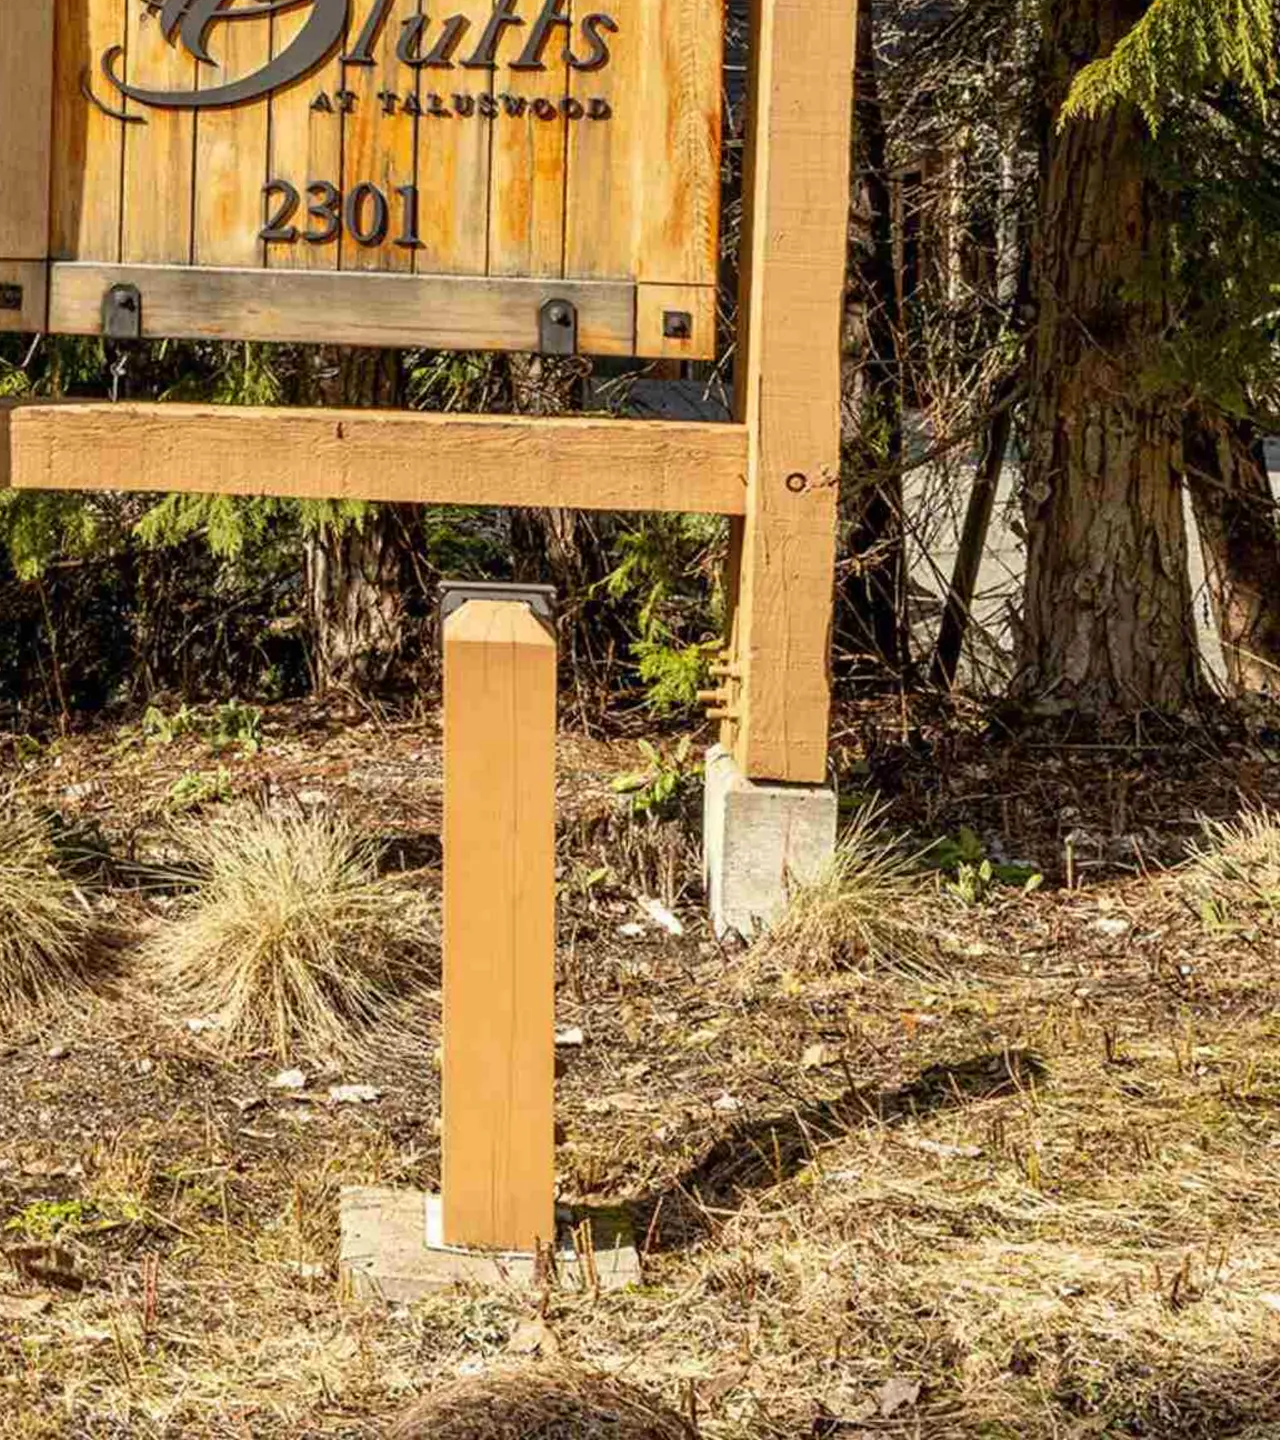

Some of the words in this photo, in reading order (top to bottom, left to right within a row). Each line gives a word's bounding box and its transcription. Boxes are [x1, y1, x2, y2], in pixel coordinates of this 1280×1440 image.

[310, 90, 357, 115] AT
[377, 90, 613, 121] TALUSWOOD
[259, 179, 426, 250] 2301
